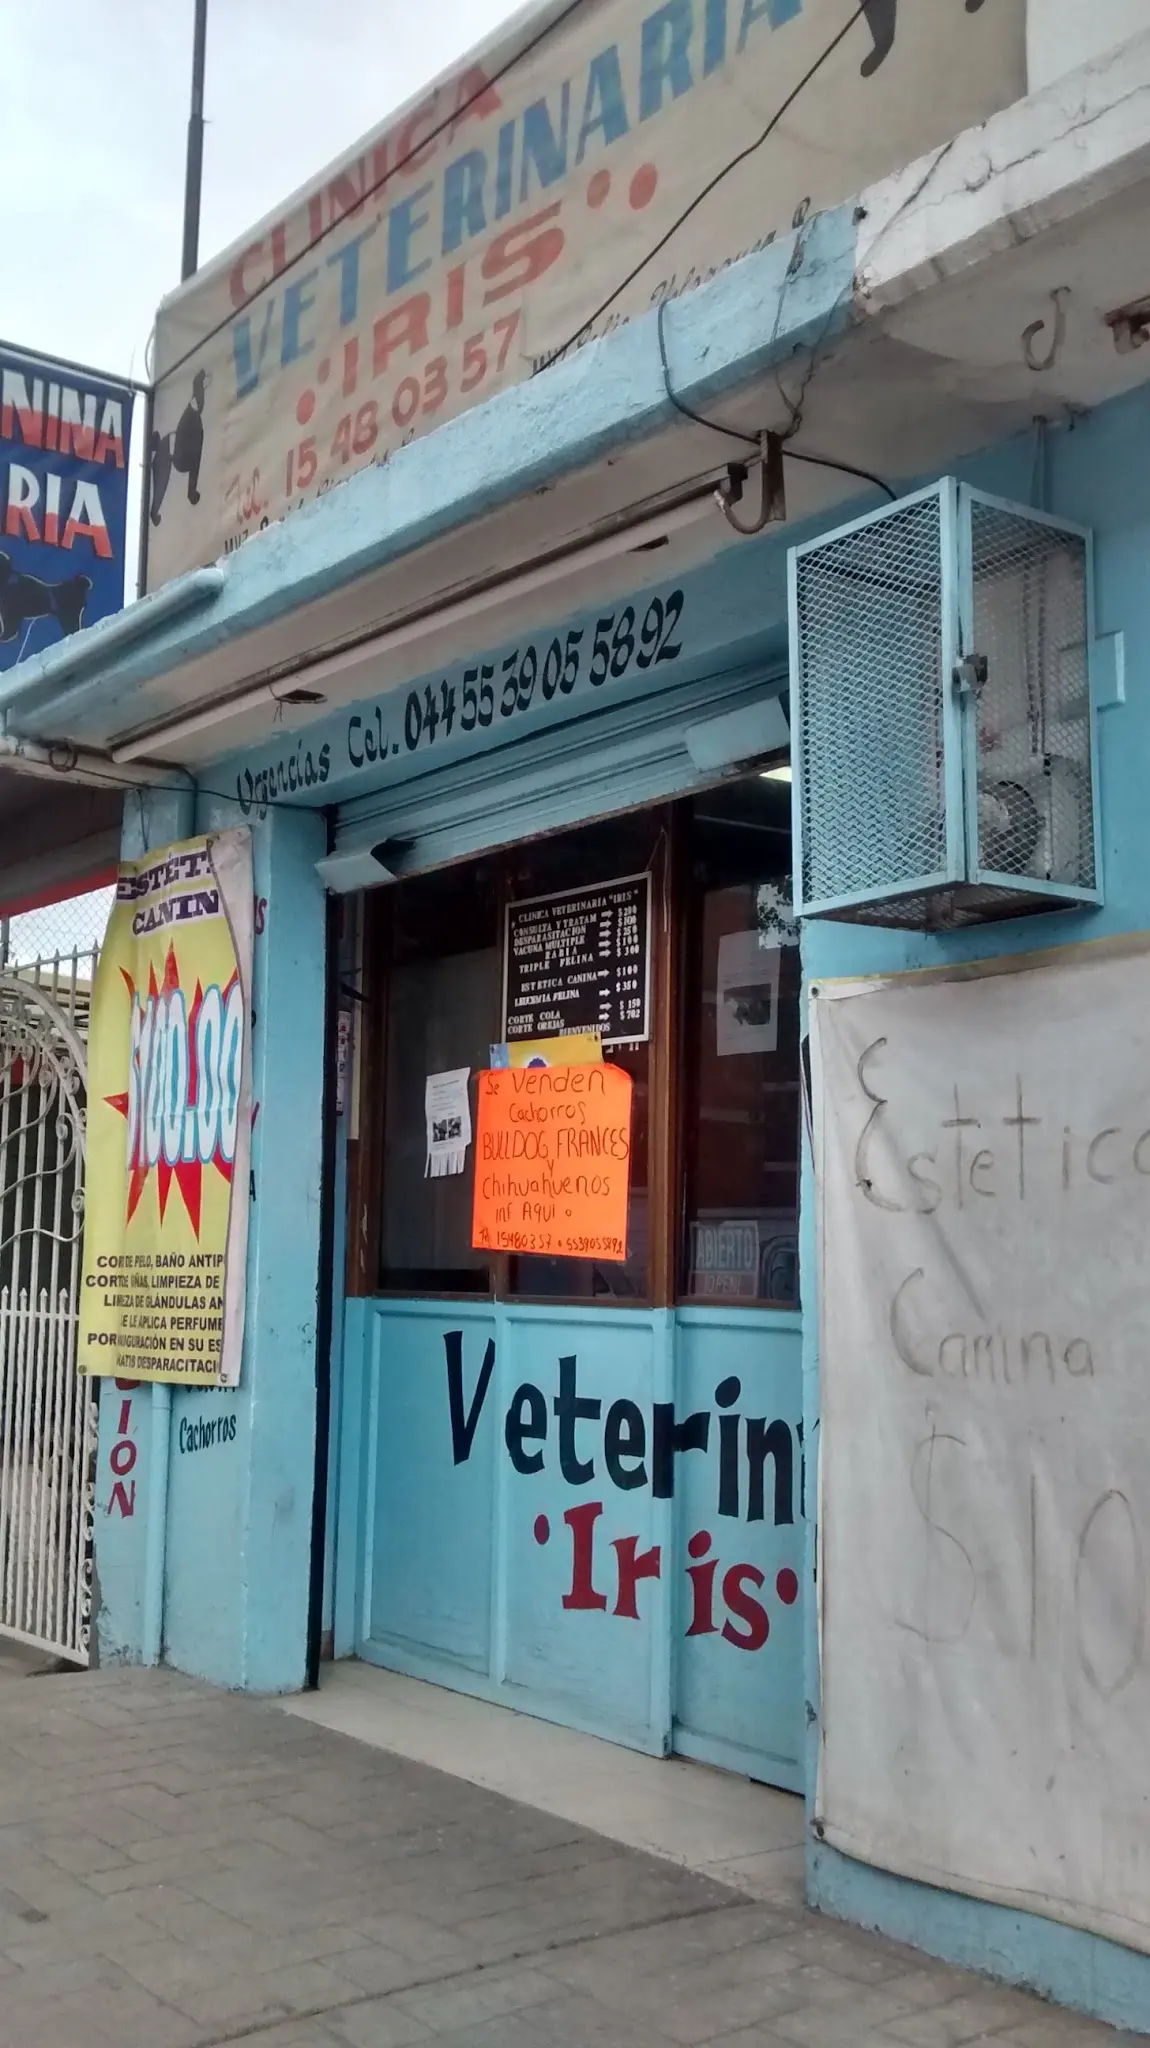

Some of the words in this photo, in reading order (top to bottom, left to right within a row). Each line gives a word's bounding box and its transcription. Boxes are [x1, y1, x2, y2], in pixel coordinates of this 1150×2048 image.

[229, 66, 503, 310] CLINICA
[343, 200, 565, 400] IRIS
[286, 435, 319, 497] 15
[331, 400, 379, 465] 48
[391, 355, 449, 428] 03
[460, 308, 521, 393] 57
[5, 463, 112, 558] RIA
[236, 738, 331, 821] Urgencias
[348, 707, 399, 768] Cel.
[518, 909, 550, 923] CLINICA
[552, 897, 607, 917] VETERINARIA
[513, 922, 552, 938] CONSULTA
[563, 912, 597, 929] TRATAM
[513, 924, 587, 947] DESPARASITACION
[512, 944, 544, 957] VACUNA
[544, 935, 586, 951] MULTIPLE
[518, 961, 551, 975] TRIPLE
[559, 953, 594, 968] FELINA
[520, 977, 564, 993] ESTETICA
[566, 971, 598, 985] CANINA
[514, 992, 552, 1008] LEUCEMIA
[552, 988, 581, 1003] FELINA
[507, 1013, 535, 1026] CORTE
[539, 1010, 561, 1021] COLA
[507, 1022, 534, 1035] CORTE
[537, 1018, 566, 1032] OREJAS
[485, 1073, 500, 1096] Se
[512, 1068, 606, 1096] Venden
[509, 1100, 586, 1125] Cachorros
[483, 1129, 549, 1161] BULLDOG
[556, 1125, 629, 1161] FRANCES
[155, 1252, 185, 1268] BAÑO
[696, 1227, 753, 1270] ABIERTO
[151, 1274, 202, 1288] LIMPIEZA
[205, 1275, 219, 1288] DE
[145, 1292, 206, 1309] GLÁNDULAS
[138, 1315, 167, 1329] APLICA
[87, 1333, 117, 1345] POR
[169, 1337, 184, 1350] EN
[187, 1338, 204, 1351] SU
[179, 1414, 237, 1454] Cachorros
[443, 1331, 806, 1526] Veterin
[562, 1502, 770, 1651] Iris
